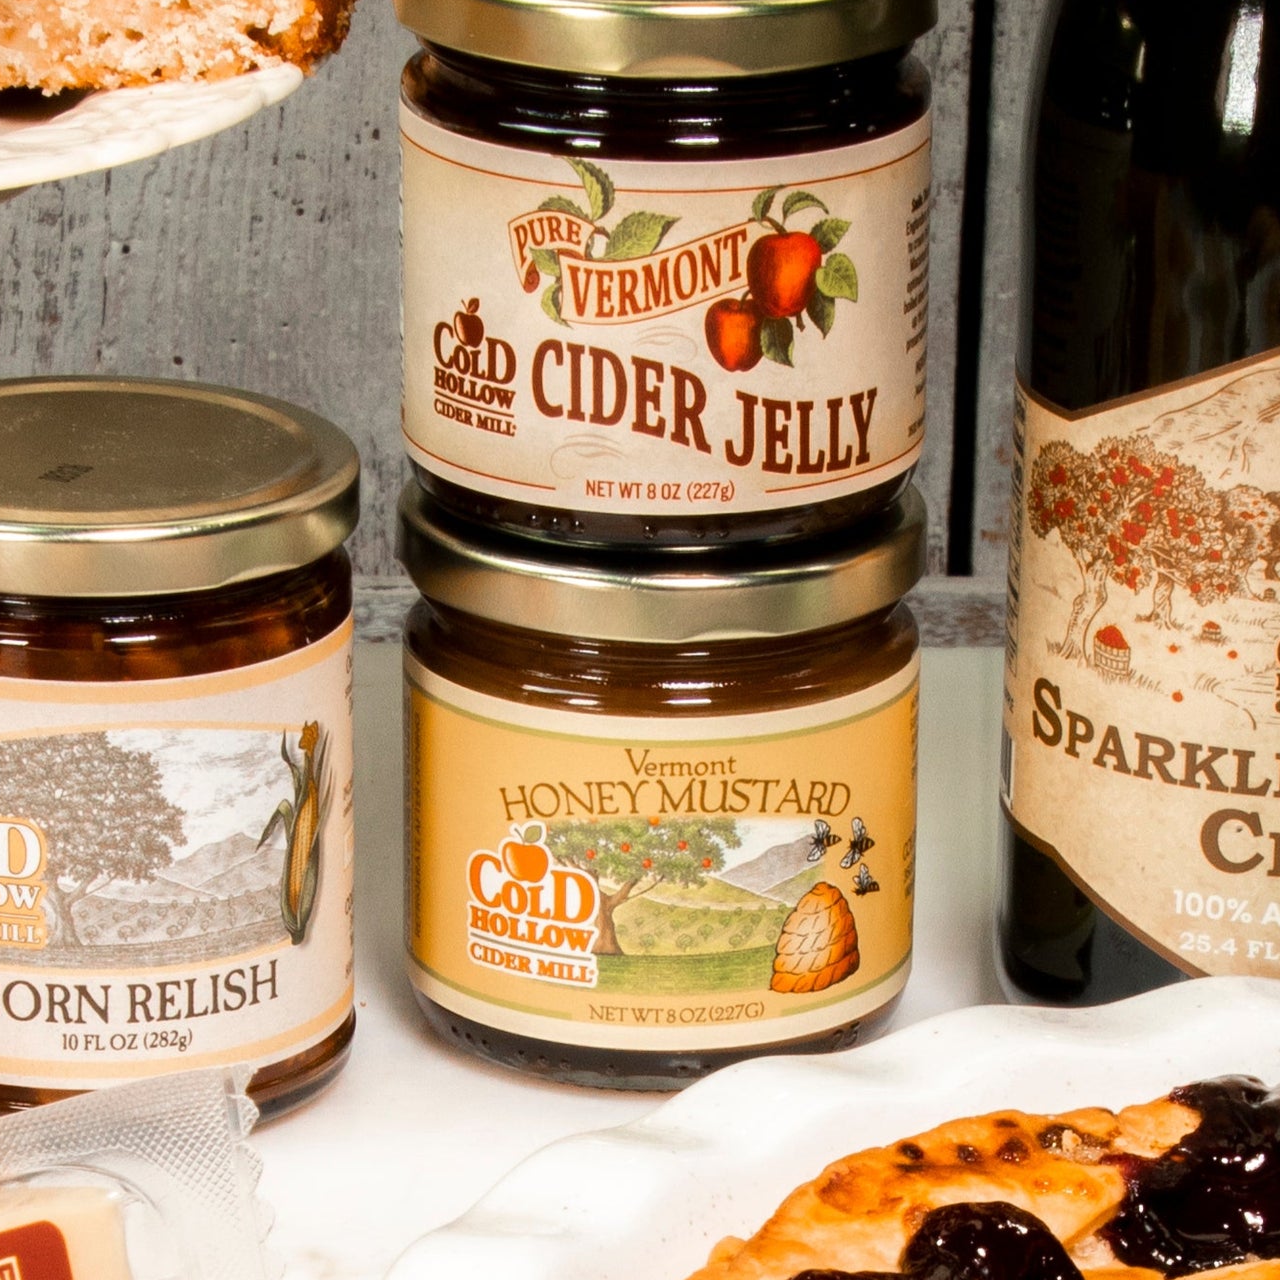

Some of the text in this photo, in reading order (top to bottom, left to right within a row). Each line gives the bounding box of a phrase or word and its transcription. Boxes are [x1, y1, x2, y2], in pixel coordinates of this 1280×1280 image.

[513, 217, 583, 269] PURE
[567, 229, 748, 318] VERMONT
[433, 322, 517, 385] COLD
[433, 366, 516, 409] HOLLOW
[531, 339, 878, 475] CIDER JELLY
[433, 398, 473, 430] CIDER
[586, 479, 735, 502] NET WT 8 OZ (227g)
[625, 749, 737, 778] Vermont
[499, 778, 851, 820] HONEY MUSTARD
[469, 852, 595, 923] COLD
[1174, 890, 1252, 923] 100%
[470, 905, 594, 952] HOLLOW
[1179, 931, 1237, 956] 25.4
[1245, 939, 1280, 961] FL
[470, 942, 532, 974] CIDER
[128, 959, 279, 1021] RELISH
[588, 1002, 765, 1024] NET WT 8 OZ (227G)
[62, 1028, 193, 1053] 10 FL OZ (282g)
